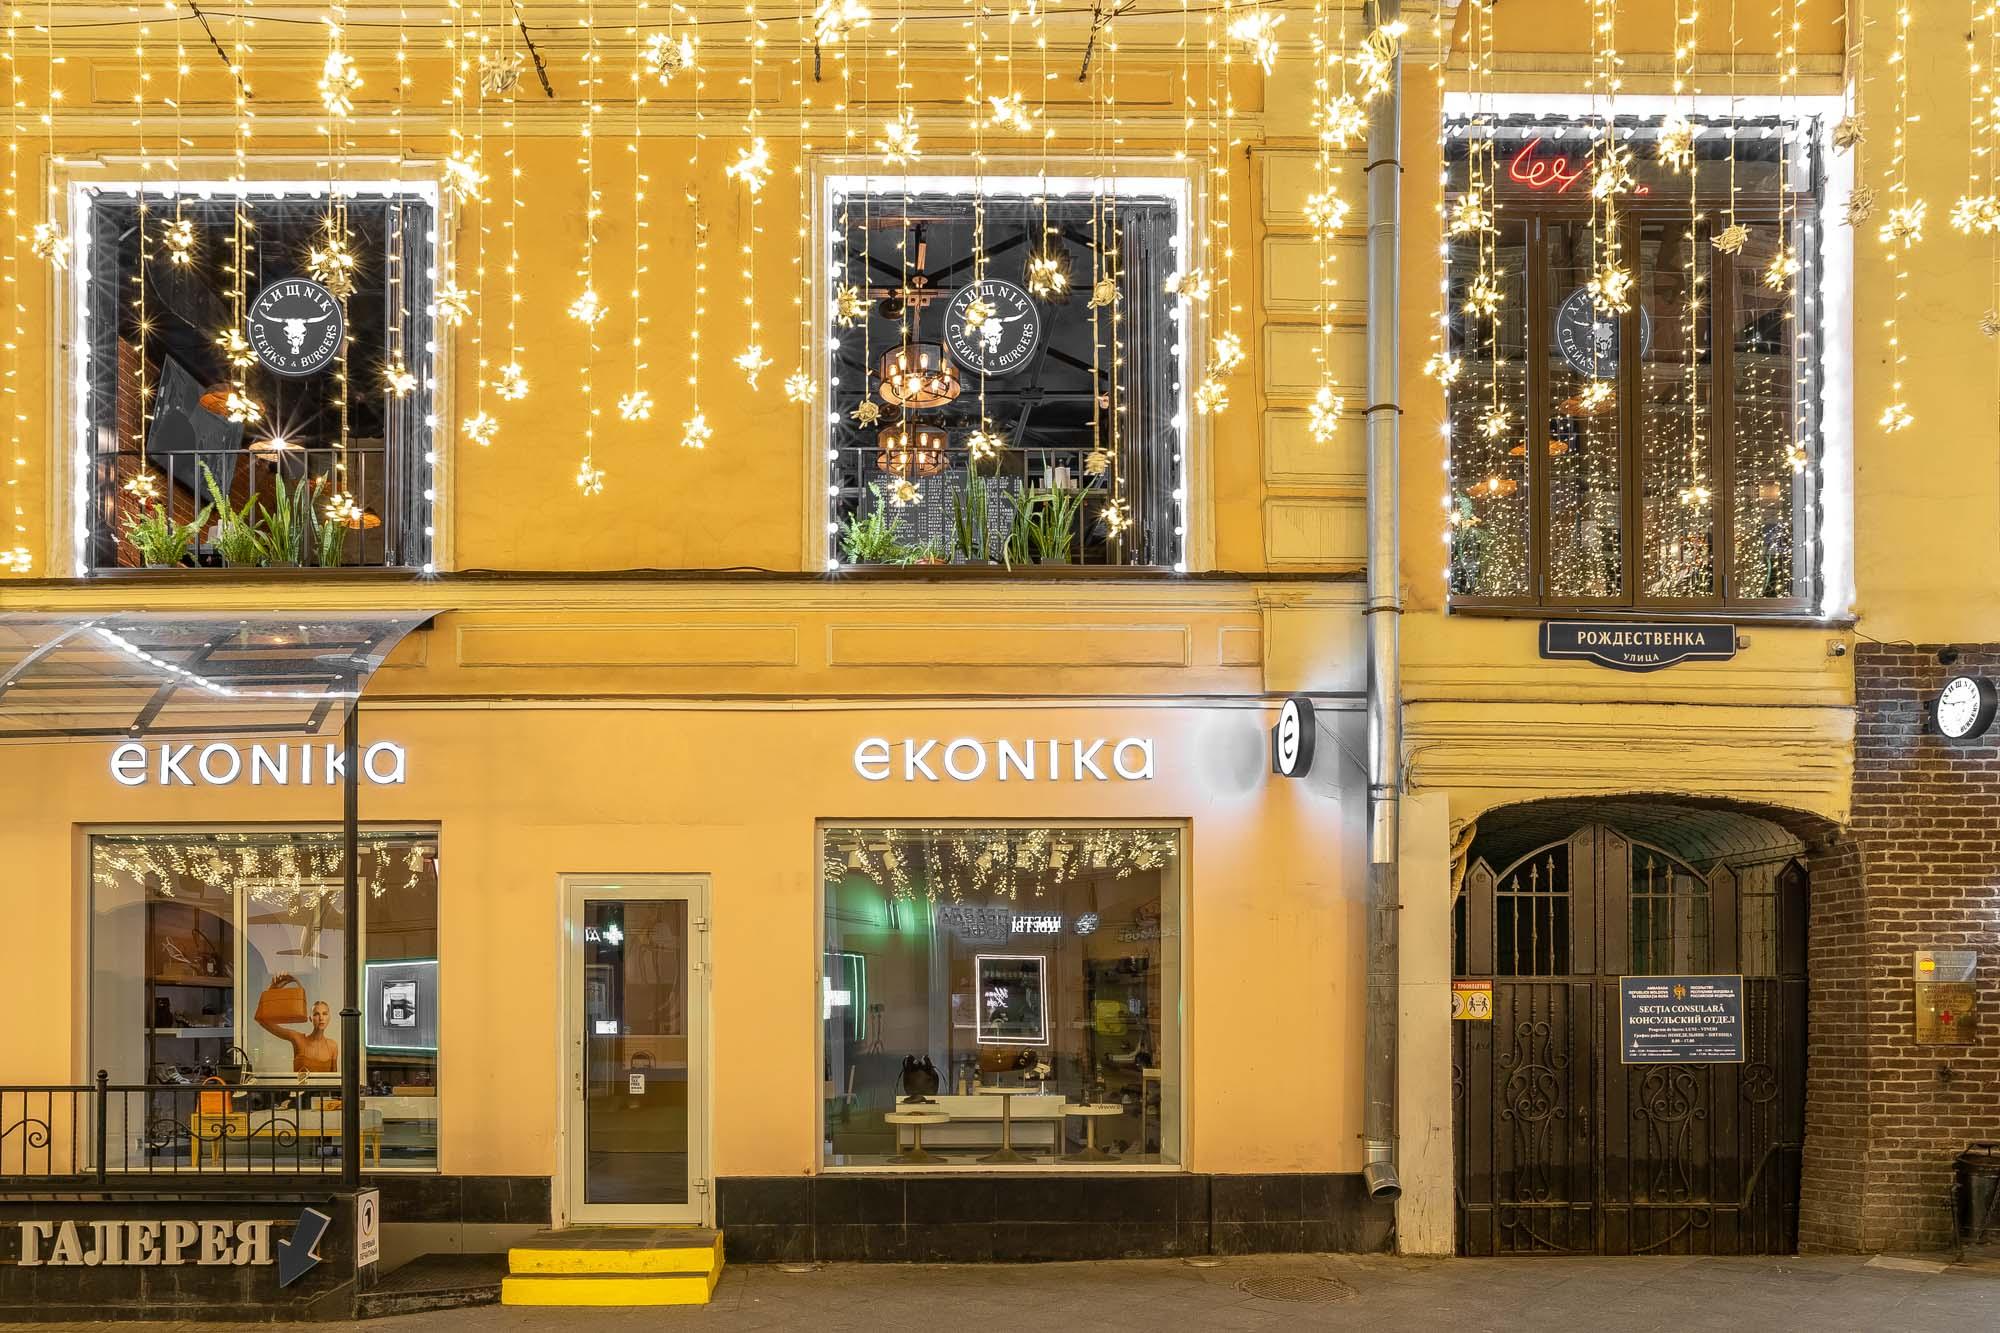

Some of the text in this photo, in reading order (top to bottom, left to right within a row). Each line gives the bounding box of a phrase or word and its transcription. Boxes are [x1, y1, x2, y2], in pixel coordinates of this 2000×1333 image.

[300, 324, 337, 367] BURGERS
[999, 323, 1034, 366] BURGERS
[1577, 631, 1706, 646] РОЖДЕСТВЕНКА
[1623, 652, 1660, 663] УЛИЦА
[1671, 1003, 1725, 1013] CONSULARĂ
[1629, 1014, 1735, 1025] КОНСУЛЬСКИЙ ОТДЕЛ
[364, 1207, 371, 1230] 1
[17, 1220, 274, 1266] ГАЛЕРЕЯ
